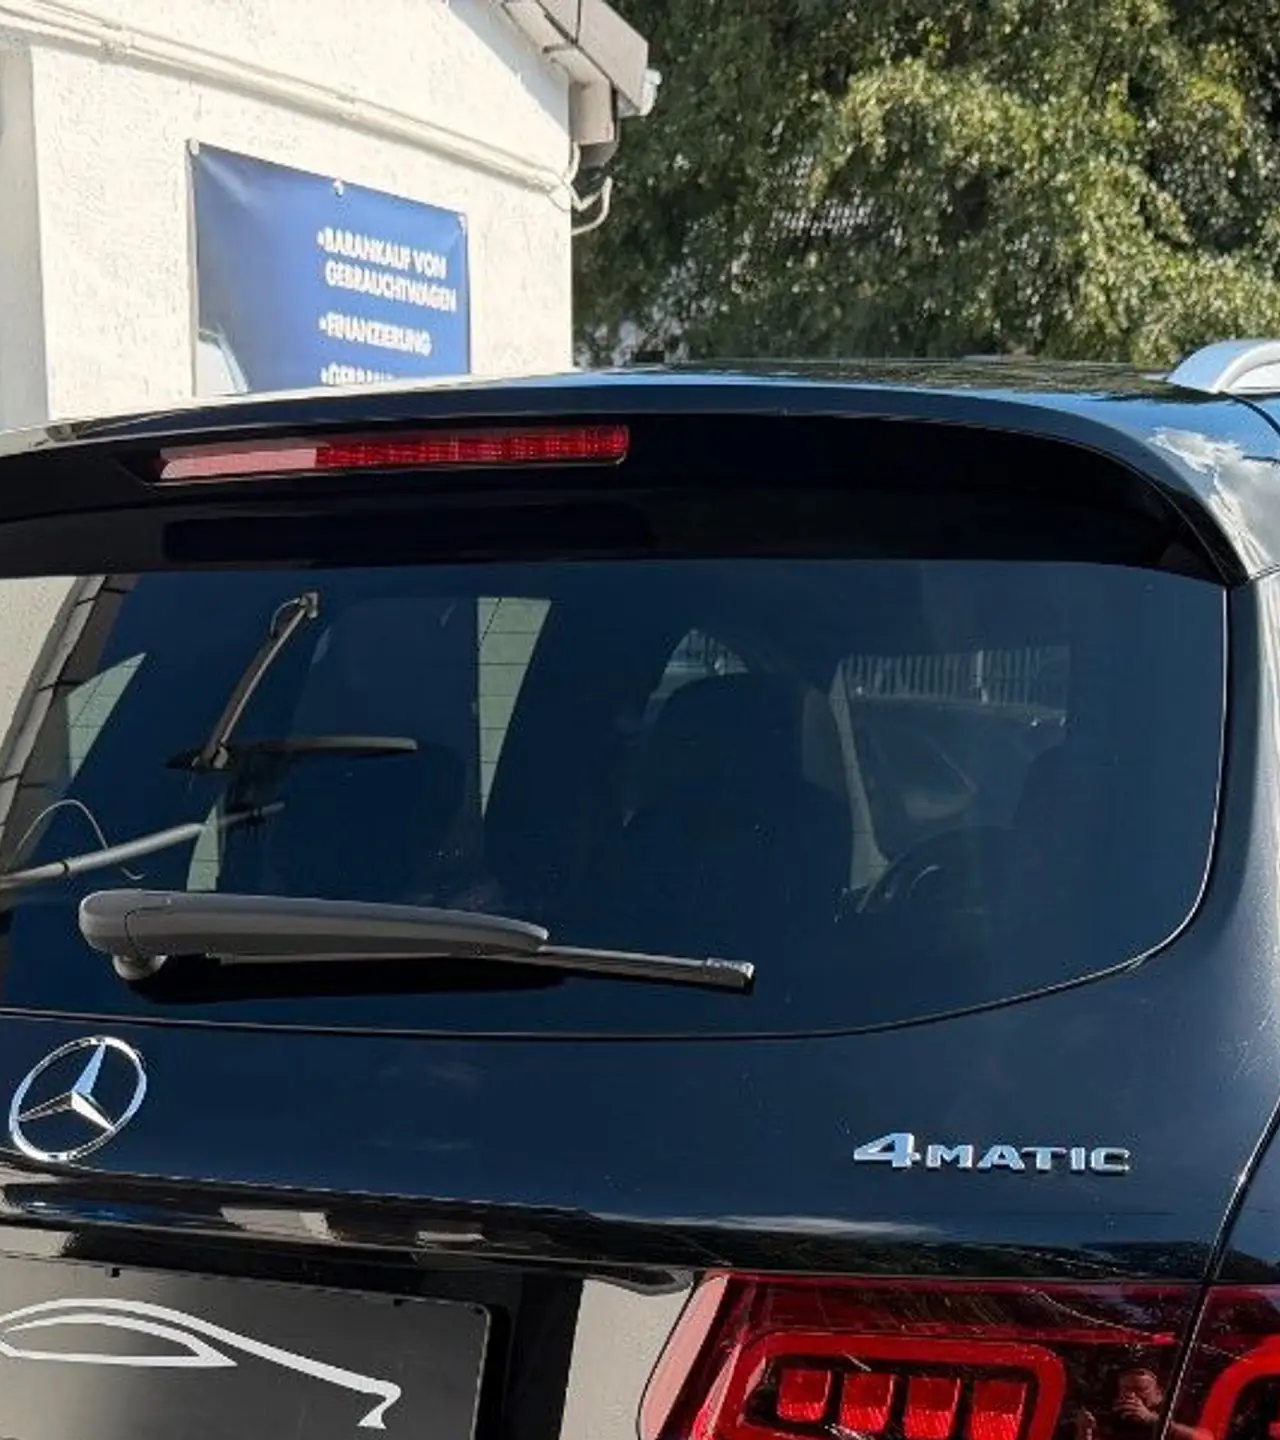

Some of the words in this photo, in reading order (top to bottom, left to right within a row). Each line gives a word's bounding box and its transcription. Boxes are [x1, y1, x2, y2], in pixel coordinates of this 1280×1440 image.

[325, 258, 457, 313] GEBRAUCHTWAGEN
[412, 250, 447, 280] VON
[853, 1132, 1131, 1173] 4MATIC
